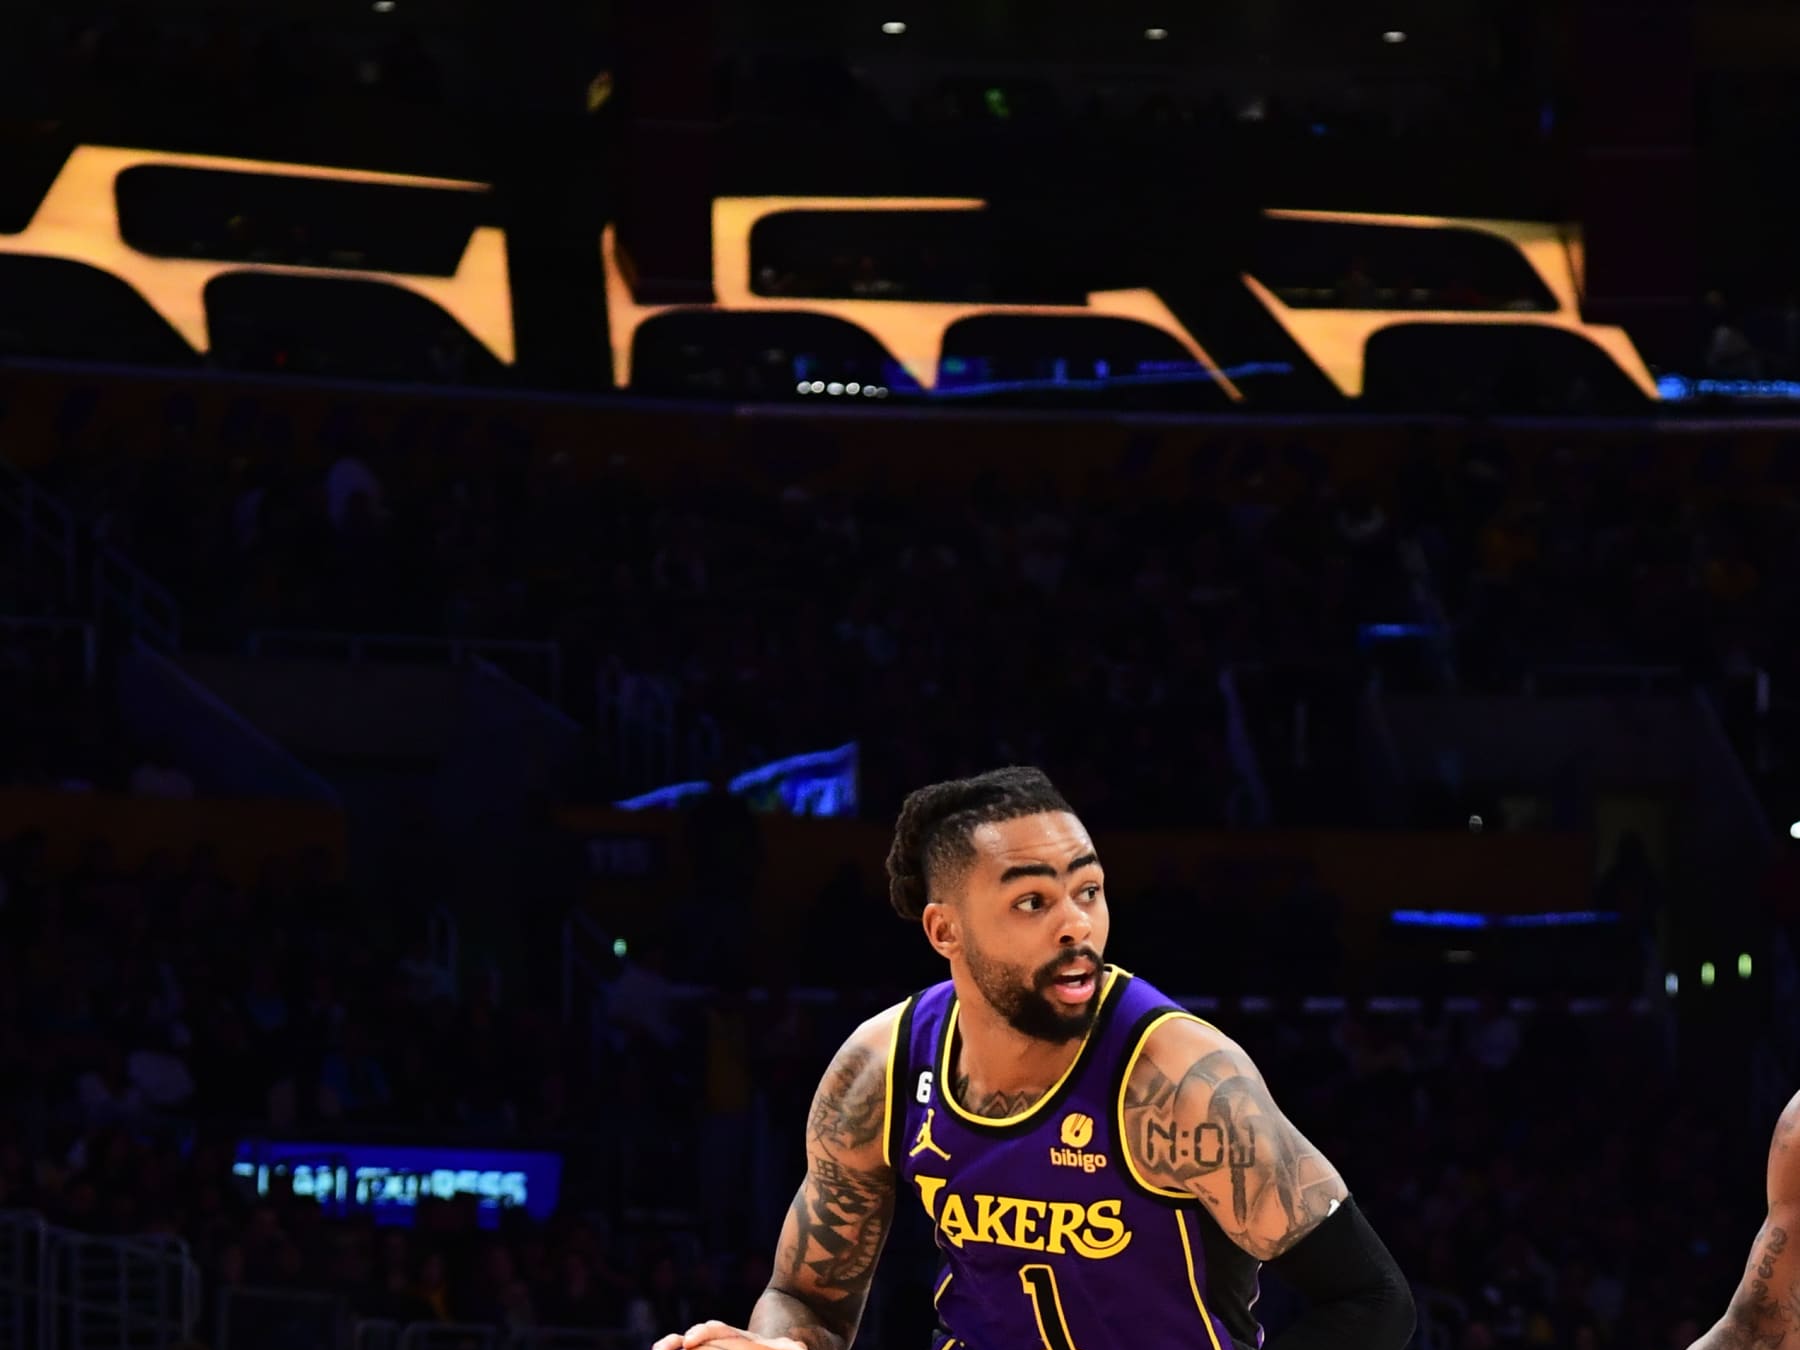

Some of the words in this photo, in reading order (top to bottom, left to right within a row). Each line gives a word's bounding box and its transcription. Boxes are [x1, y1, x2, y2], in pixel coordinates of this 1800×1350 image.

[916, 1071, 934, 1104] 6
[1050, 1147, 1107, 1174] bibigo
[914, 1175, 1132, 1259] LAKERS
